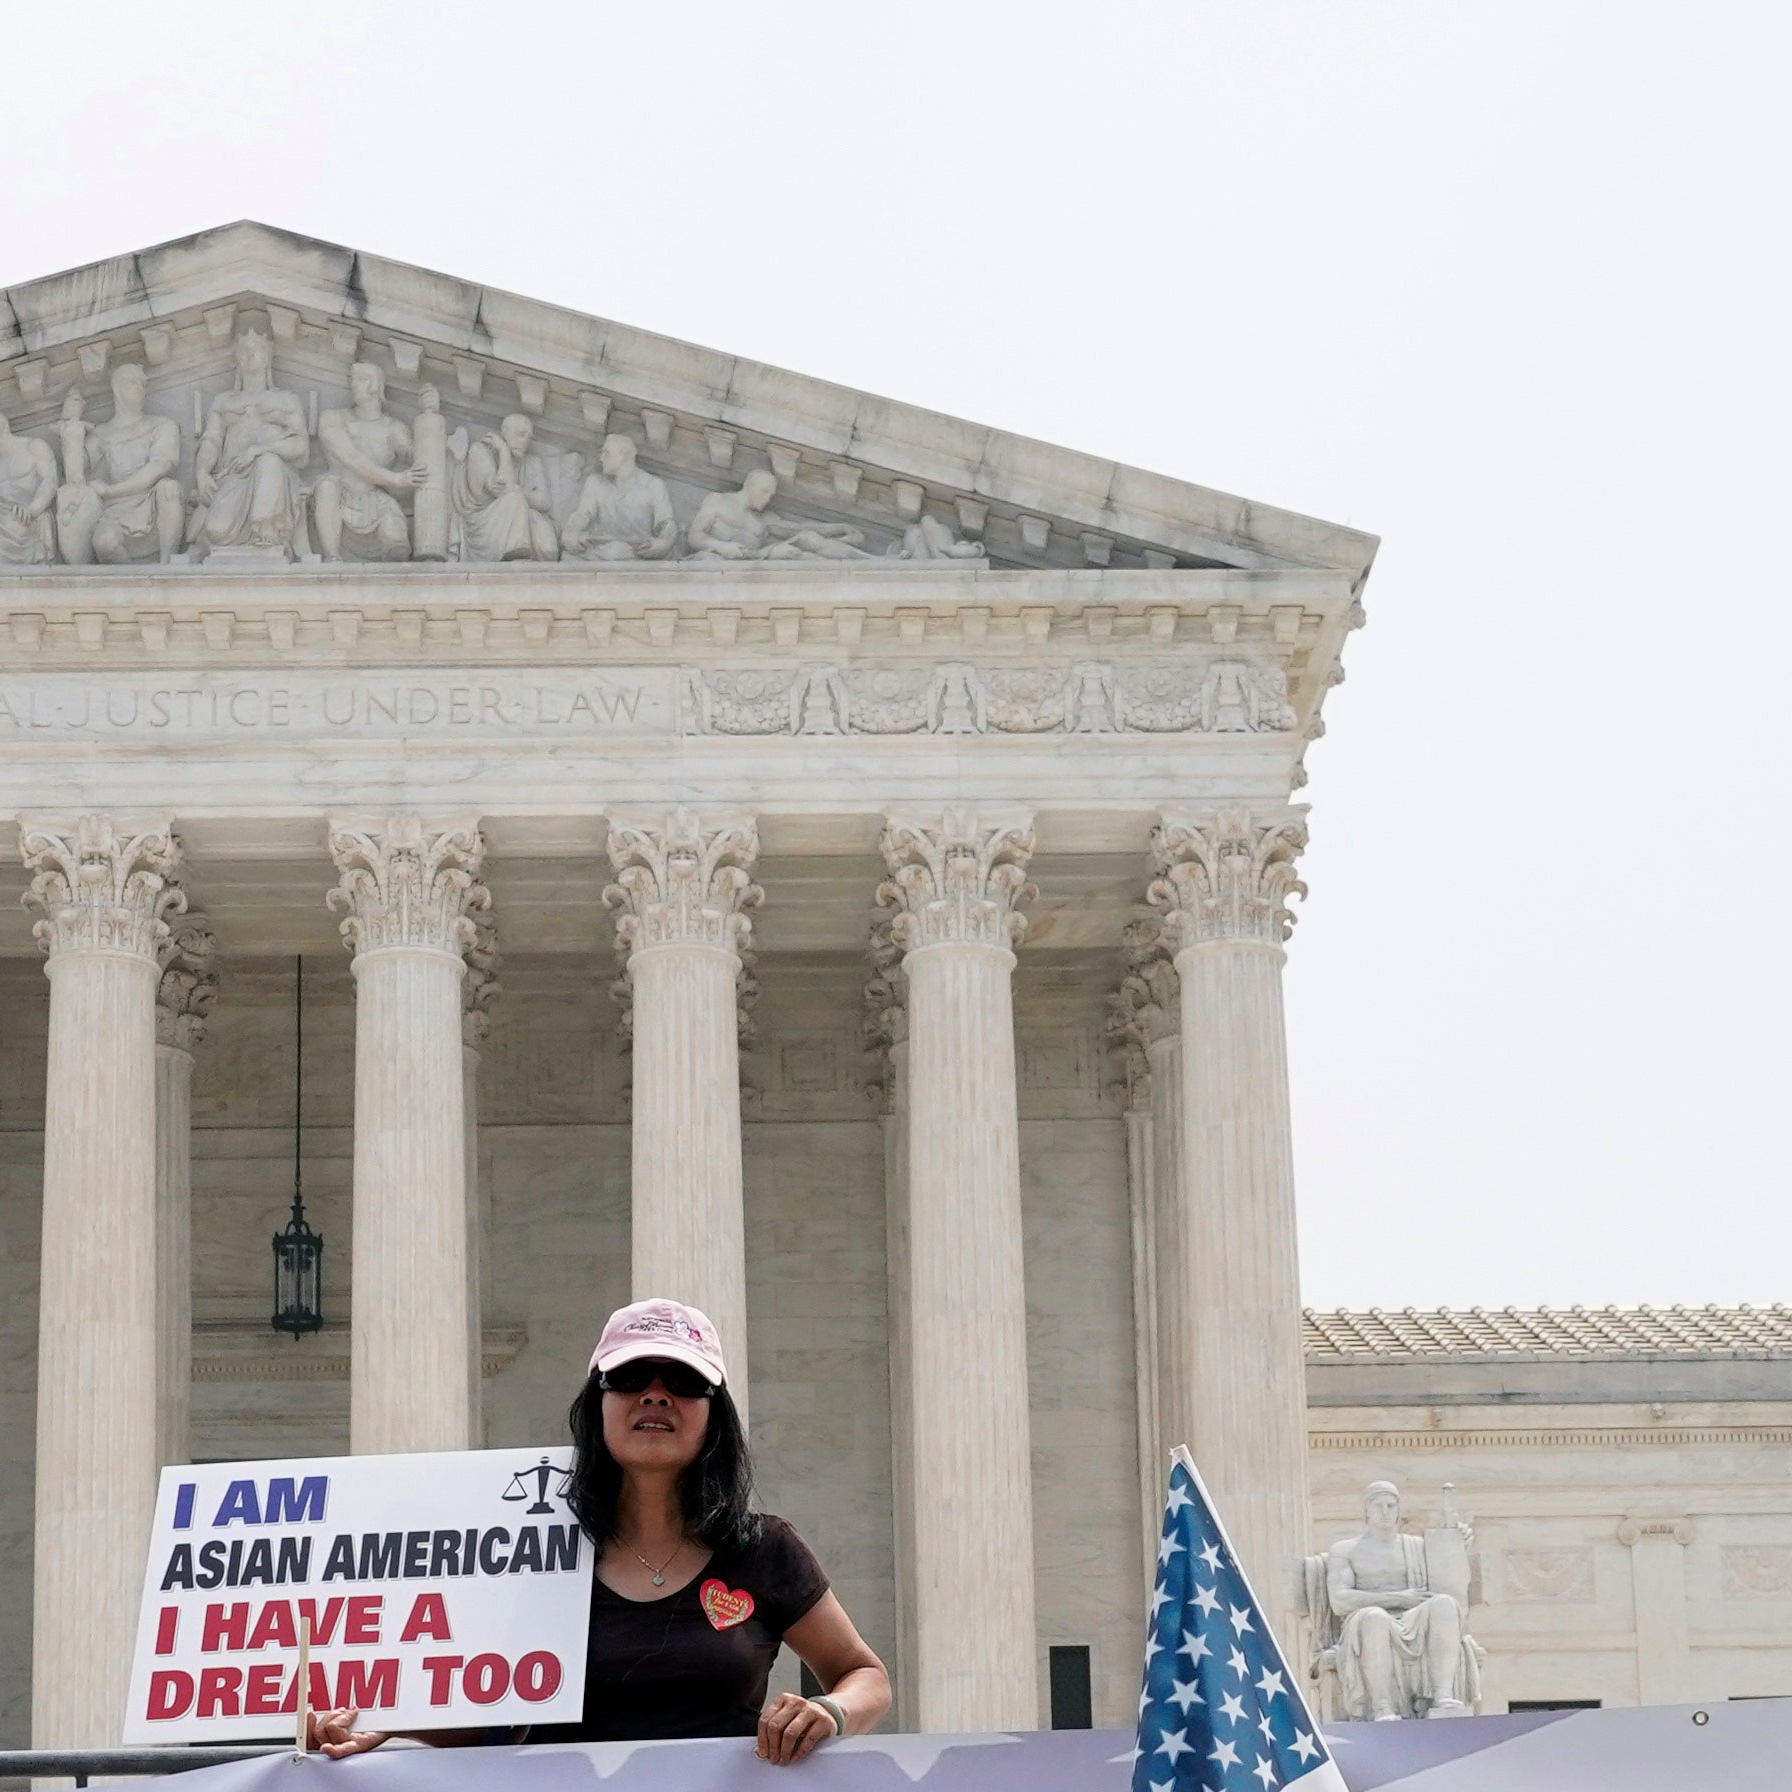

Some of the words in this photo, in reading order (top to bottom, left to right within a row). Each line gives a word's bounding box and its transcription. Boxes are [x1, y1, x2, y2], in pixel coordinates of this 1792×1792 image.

[66, 688, 310, 731] JUSTICE
[322, 686, 521, 728] UNDER
[535, 684, 644, 727] LAW
[172, 1483, 196, 1530] I
[211, 1475, 329, 1526] AM
[160, 1536, 312, 1591] ASIAN
[322, 1524, 580, 1582] AMERICAN
[155, 1606, 179, 1655] I
[200, 1598, 383, 1653] HAVE
[399, 1593, 453, 1643] A
[145, 1657, 401, 1722] DREAM
[422, 1650, 564, 1706] TOO
